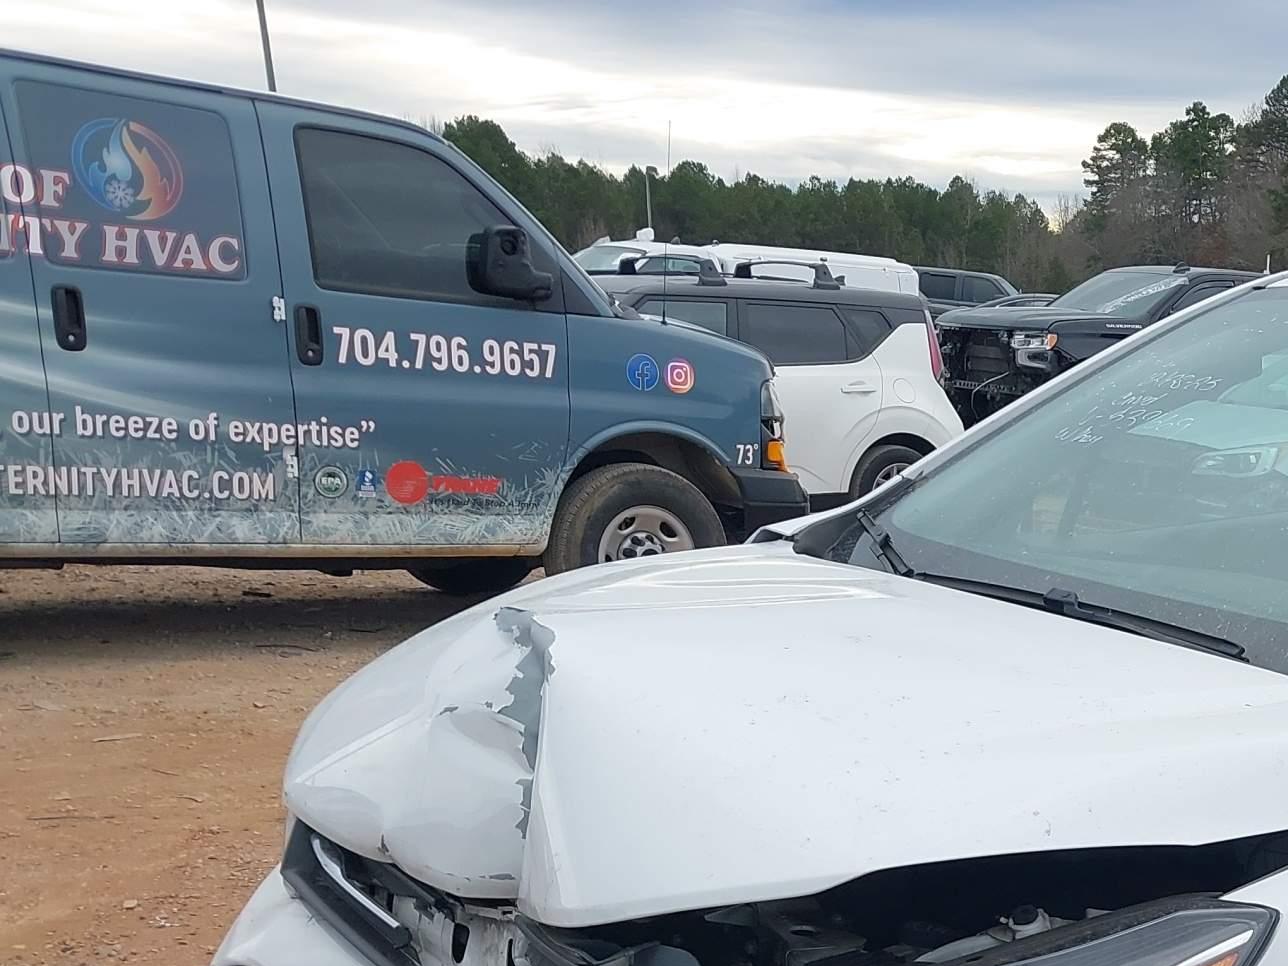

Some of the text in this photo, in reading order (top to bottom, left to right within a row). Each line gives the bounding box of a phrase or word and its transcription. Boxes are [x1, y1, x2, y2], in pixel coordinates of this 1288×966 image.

[0, 164, 71, 207] OF
[101, 225, 240, 272] HVAC
[332, 326, 556, 378] 704.796.9657
[11, 410, 65, 434] our
[75, 406, 179, 440] breeze
[189, 412, 218, 441] of
[0, 464, 275, 500] ERNITYHVAC.COM
